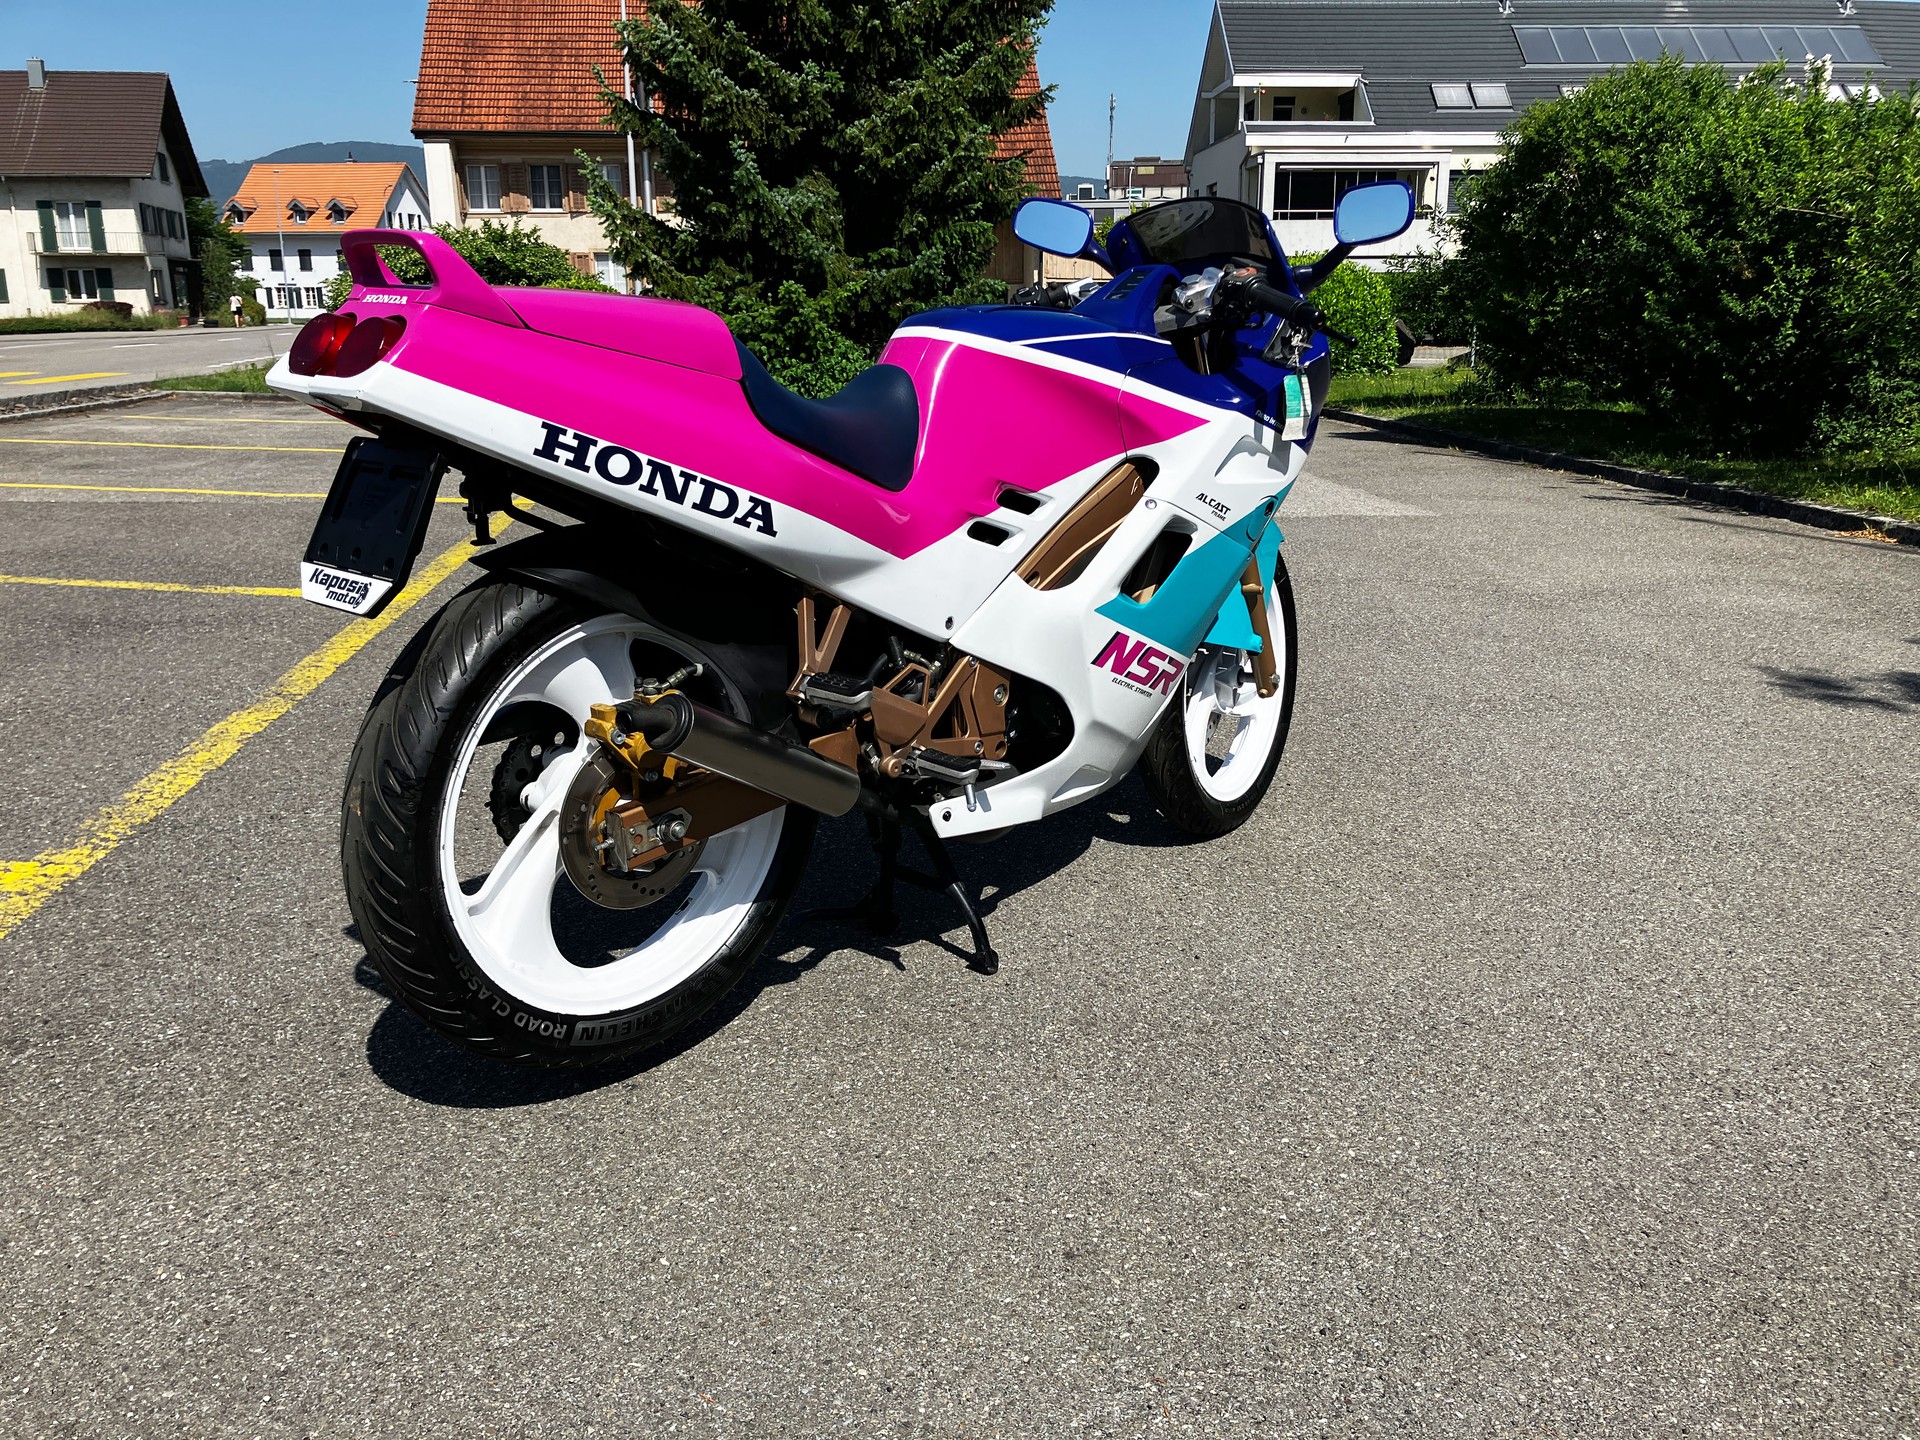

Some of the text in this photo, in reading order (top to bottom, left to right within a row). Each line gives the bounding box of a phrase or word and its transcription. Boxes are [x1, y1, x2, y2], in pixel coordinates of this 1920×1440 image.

[362, 294, 408, 305] HONDA
[533, 420, 778, 538] HONDA
[1195, 492, 1231, 515] ALCAST
[309, 567, 365, 594] Kaposi
[326, 590, 357, 606] moto
[1090, 630, 1185, 697] NSR
[1112, 677, 1135, 691] ELECTRIC
[449, 951, 691, 1042] MICHELIN ROAD CLASSIC
